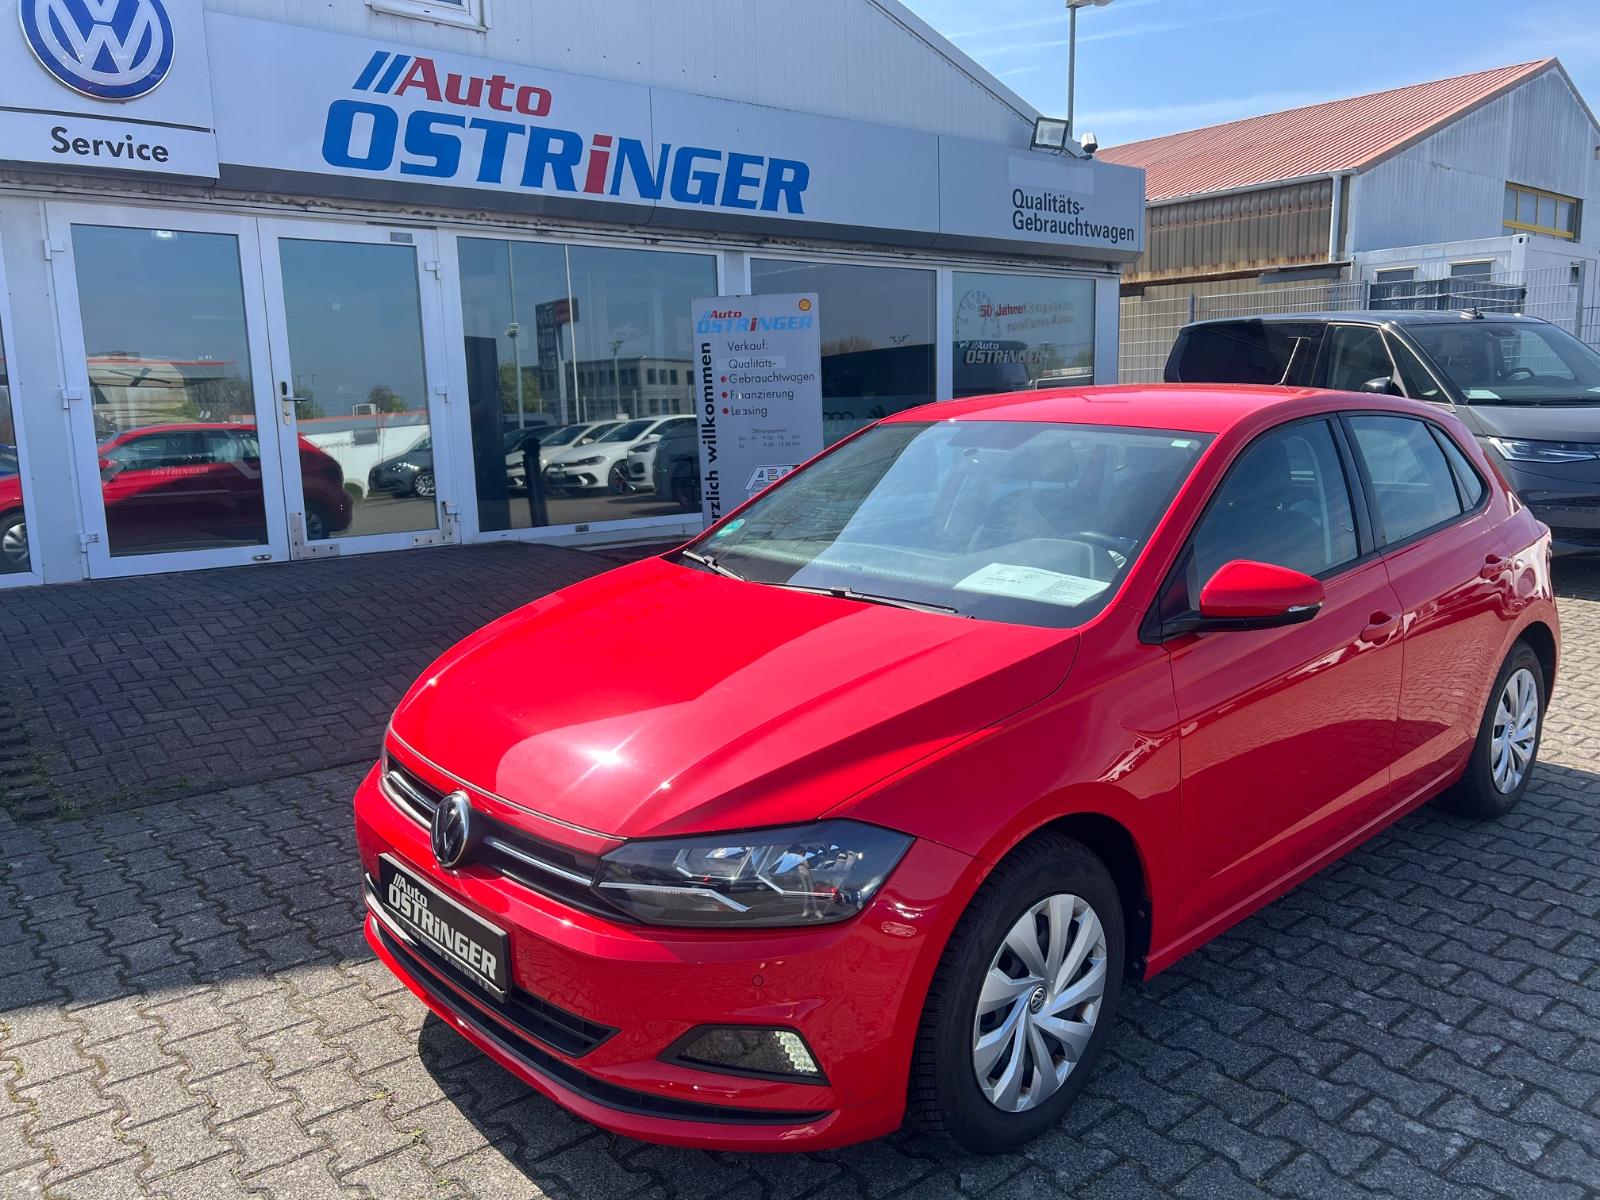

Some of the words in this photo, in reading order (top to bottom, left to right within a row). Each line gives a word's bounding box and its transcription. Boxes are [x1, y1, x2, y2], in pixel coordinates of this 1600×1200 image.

[51, 127, 168, 162] Service
[1012, 189, 1085, 215] Qualitäts-
[1012, 211, 1134, 244] Gebrauchtwagen
[996, 303, 1024, 317] Jahre
[729, 359, 777, 369] Qualitäts-
[729, 371, 815, 383] Gebrauchtwagen
[730, 390, 794, 400] Finanzierung
[701, 342, 718, 463] willkommen
[731, 406, 768, 417] Leasing
